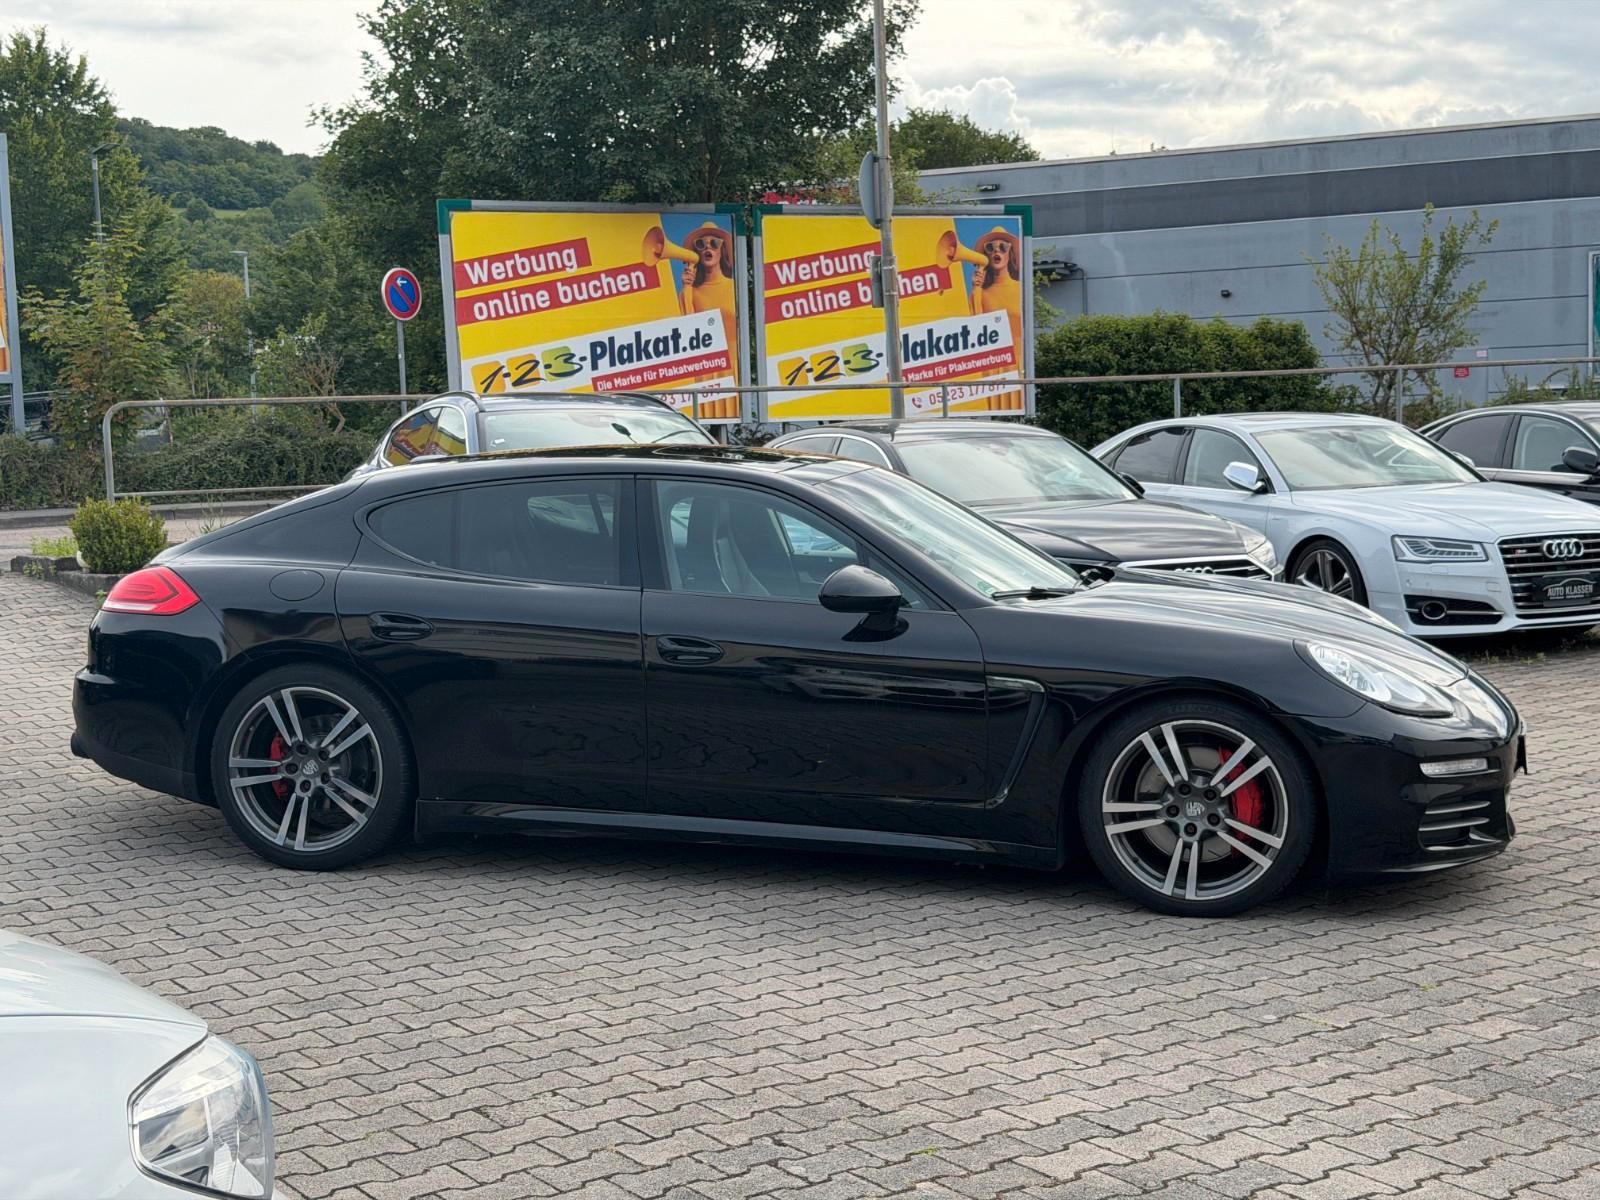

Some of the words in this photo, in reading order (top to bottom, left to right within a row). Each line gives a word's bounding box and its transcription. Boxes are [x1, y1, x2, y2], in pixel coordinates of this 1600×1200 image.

[464, 247, 578, 285] Werbung
[773, 249, 875, 285] Werbung
[473, 286, 551, 321] online
[556, 268, 647, 304] buchen
[780, 289, 851, 319] online
[857, 272, 939, 303] bhen
[785, 324, 1000, 386] 1-2-3-lakat.de
[907, 370, 933, 382] Marke
[935, 366, 948, 376] für
[948, 352, 1012, 372] Plakatwerbung
[597, 380, 613, 391] Die
[614, 376, 642, 388] Marke
[643, 370, 657, 381] für
[659, 357, 727, 378] Plakatwerbung
[1547, 587, 1564, 597] AUTO
[1565, 584, 1593, 595] KLASSEN
